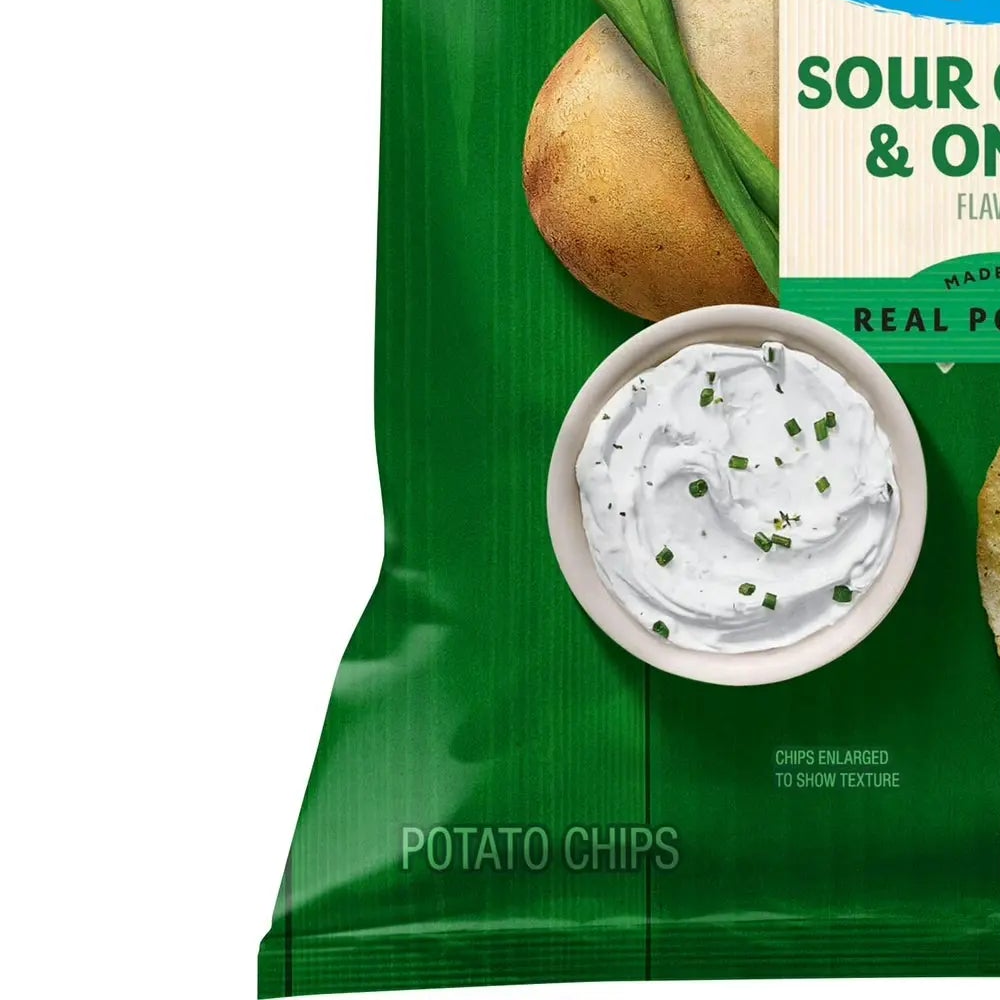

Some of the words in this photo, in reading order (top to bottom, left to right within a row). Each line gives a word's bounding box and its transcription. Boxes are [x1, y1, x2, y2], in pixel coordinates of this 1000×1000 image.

[797, 55, 980, 110] SOUR
[865, 123, 914, 178] &
[853, 306, 950, 333] REAL
[775, 750, 815, 766] CHIPS
[818, 750, 890, 766] ENLARGED
[775, 772, 793, 788] TO
[796, 772, 838, 788] SHOW
[841, 772, 901, 788] TEXTURE
[401, 826, 550, 871] POTATO
[564, 826, 680, 871] CHIPS
